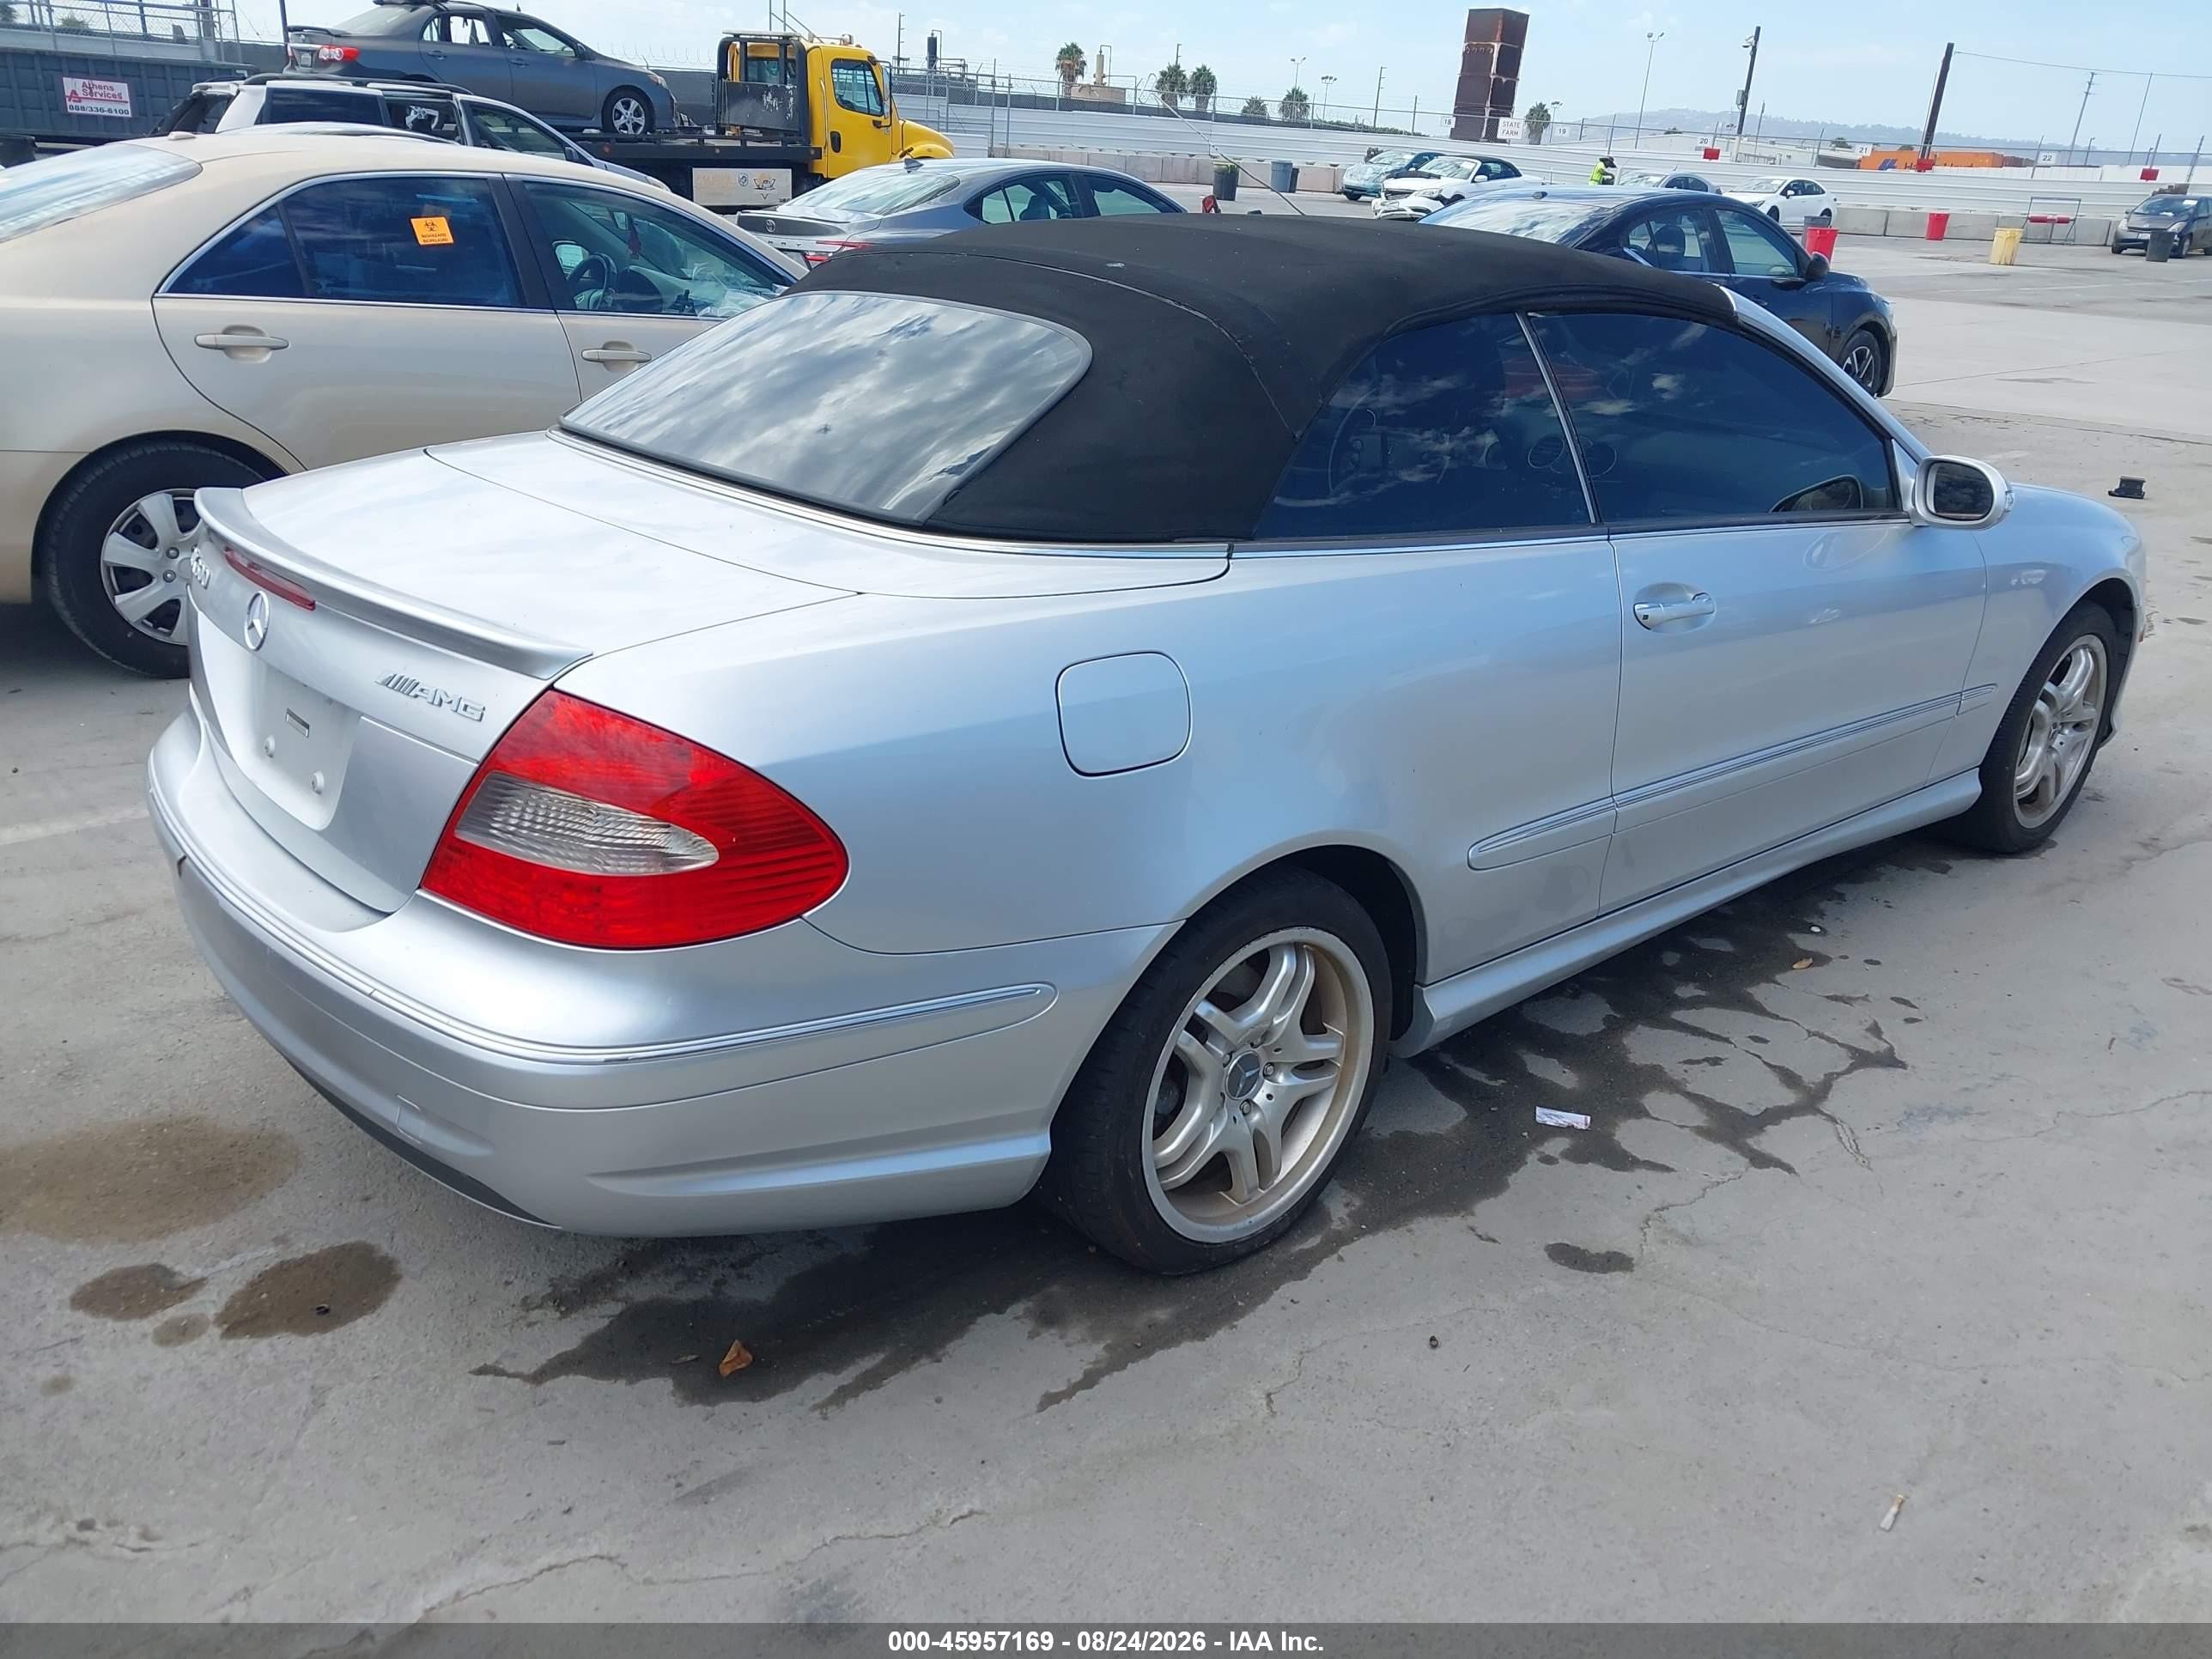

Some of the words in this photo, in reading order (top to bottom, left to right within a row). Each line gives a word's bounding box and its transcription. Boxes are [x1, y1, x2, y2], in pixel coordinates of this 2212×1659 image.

[82, 81, 114, 92] Athens
[82, 88, 123, 100] Services
[1858, 146, 1869, 155] 21
